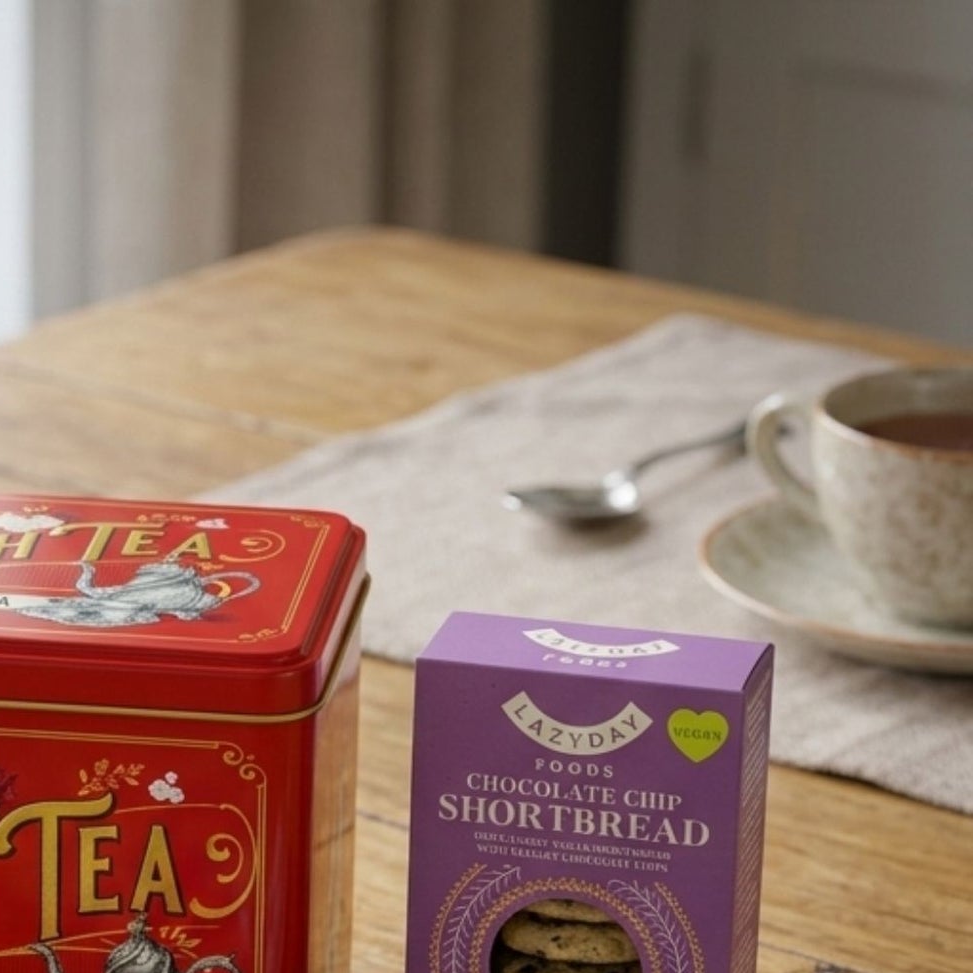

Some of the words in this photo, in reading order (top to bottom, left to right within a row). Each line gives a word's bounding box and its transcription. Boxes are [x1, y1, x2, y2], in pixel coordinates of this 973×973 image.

[49, 521, 212, 562] TEA
[512, 702, 640, 749] LAZYDAY
[673, 725, 722, 742] VEGAN
[534, 758, 614, 778] FOODS
[466, 772, 617, 806] CHOCOLATE
[622, 789, 683, 811] CHIP
[437, 793, 711, 847] SHORTBREAD
